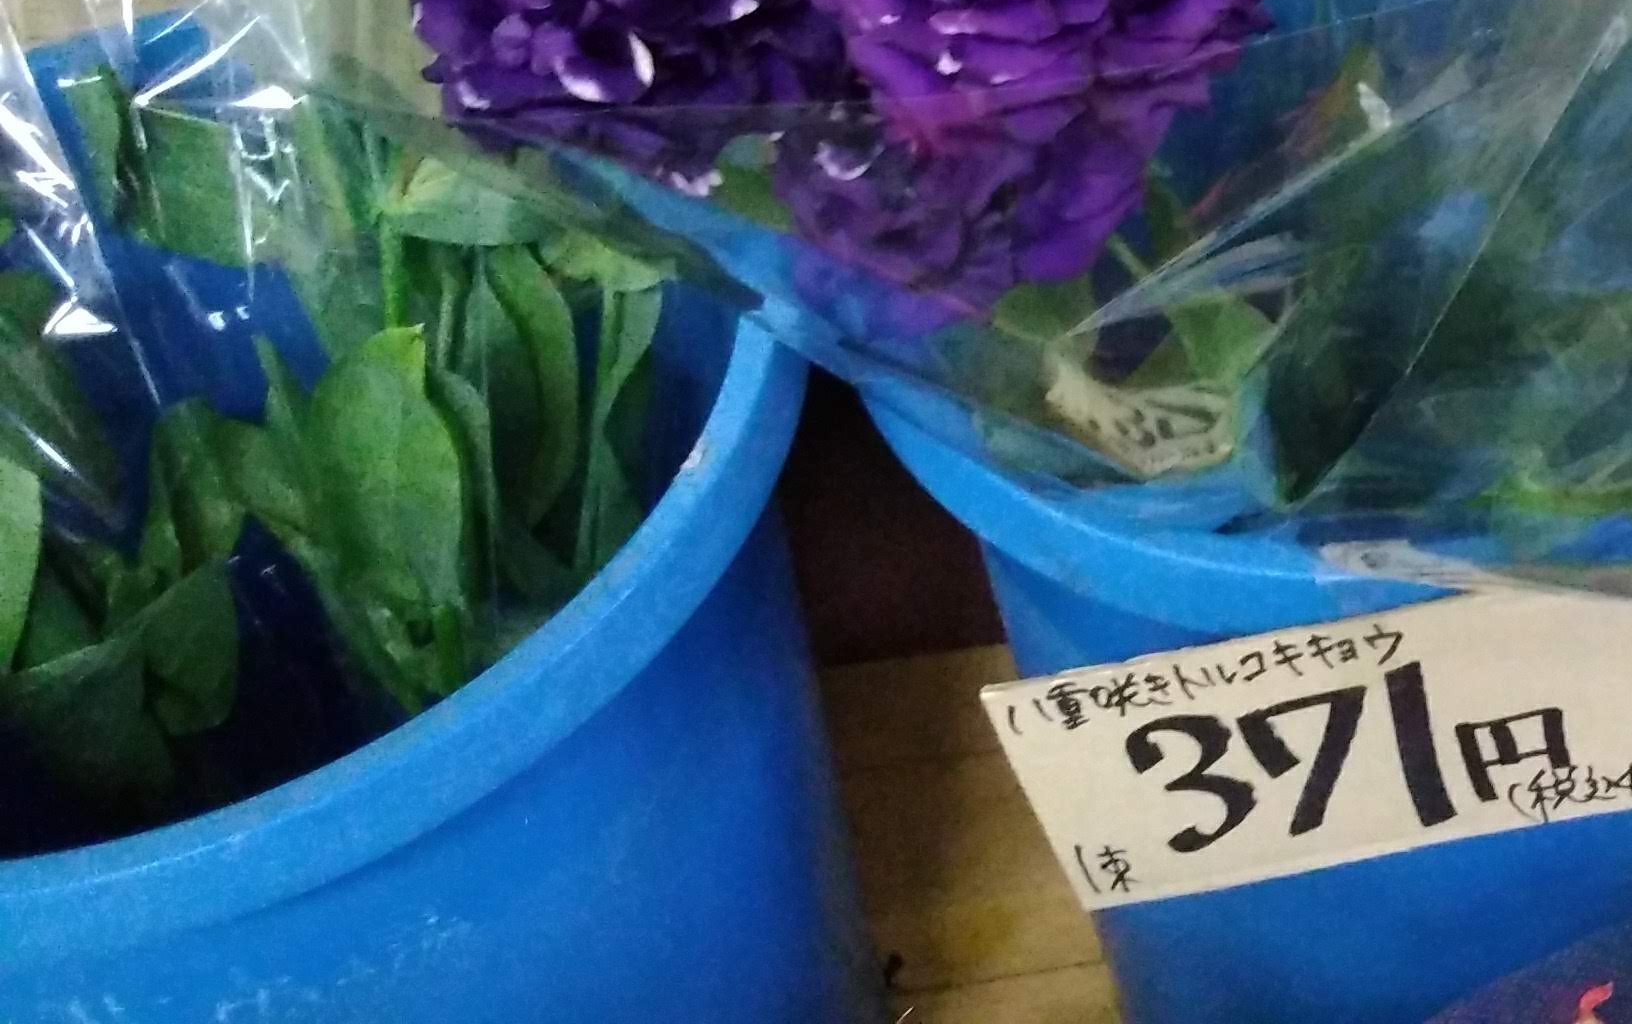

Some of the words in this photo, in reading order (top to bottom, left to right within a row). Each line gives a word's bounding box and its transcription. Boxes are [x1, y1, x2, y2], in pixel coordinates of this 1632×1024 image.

[1006, 624, 1405, 735] 八重咲きトルコキキョウ
[1125, 660, 1571, 854] 371円
